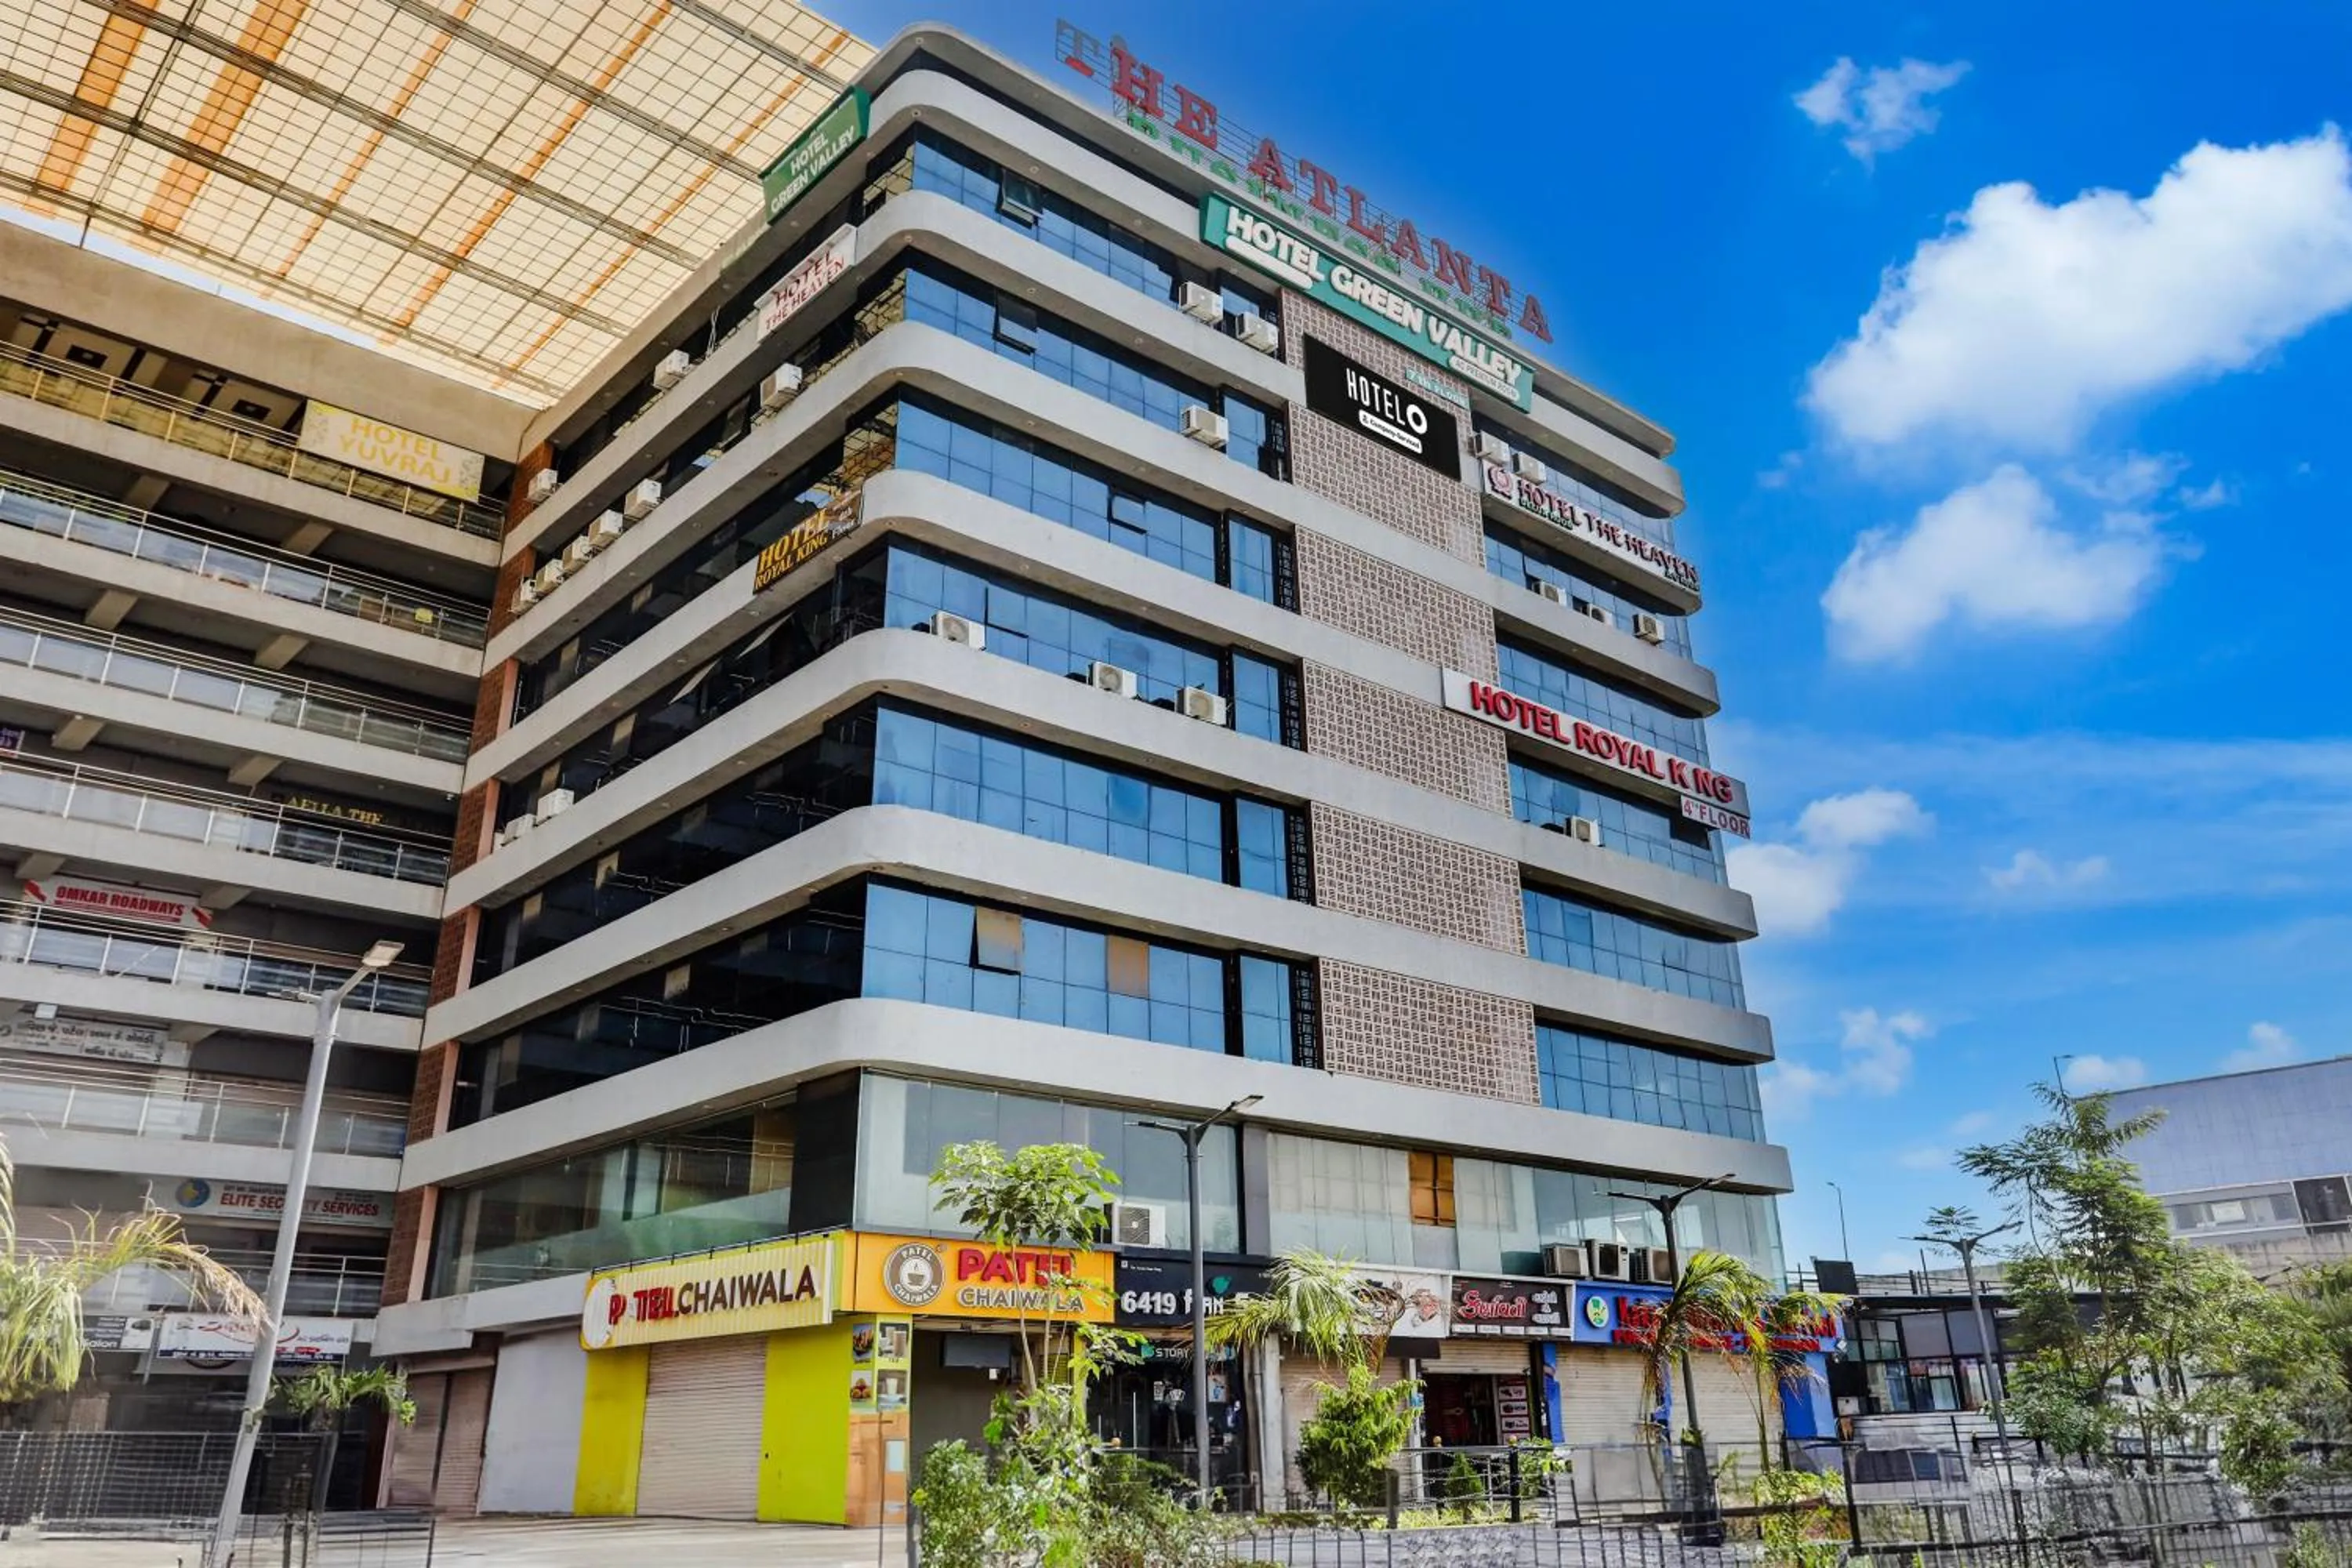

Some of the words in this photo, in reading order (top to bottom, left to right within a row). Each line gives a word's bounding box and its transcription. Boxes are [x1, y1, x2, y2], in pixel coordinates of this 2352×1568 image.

[771, 169, 809, 213] GREEN
[810, 125, 855, 176] VALLEY
[790, 132, 829, 176] HOTEL
[1055, 18, 1218, 151] THE
[1246, 137, 1555, 345] ATLANTA
[766, 303, 788, 330] THE
[791, 256, 844, 312] HEAVEN
[771, 249, 831, 307] HOTEL
[1226, 206, 1326, 282] HOTEL
[1330, 264, 1425, 335] GREEN
[1427, 315, 1523, 387] VALLEY
[339, 434, 452, 485] YUVRAJ
[350, 417, 445, 463] HOTEL
[759, 507, 828, 573] HOTEL
[1517, 479, 1582, 526] HOTEL
[1583, 511, 1622, 548] THE
[1624, 534, 1699, 584] HEAVEN
[755, 555, 793, 590] ROYAL
[796, 533, 829, 563] KING
[1470, 681, 1571, 745] HOTEL
[1573, 721, 1666, 780] ROYAL
[1700, 806, 1751, 839] FLOOR
[55, 886, 108, 904] OMKAR
[110, 893, 185, 916] ROADWAYS
[220, 1192, 256, 1207] ELITE
[258, 1196, 321, 1213] SECTY
[321, 1200, 379, 1216] SERVICES
[901, 1245, 932, 1261] PATEL
[608, 1286, 679, 1325] PTEL
[677, 1264, 816, 1315] CHAIWALA
[893, 1283, 941, 1305] CHAIWALA
[1120, 1290, 1176, 1315] 6419
